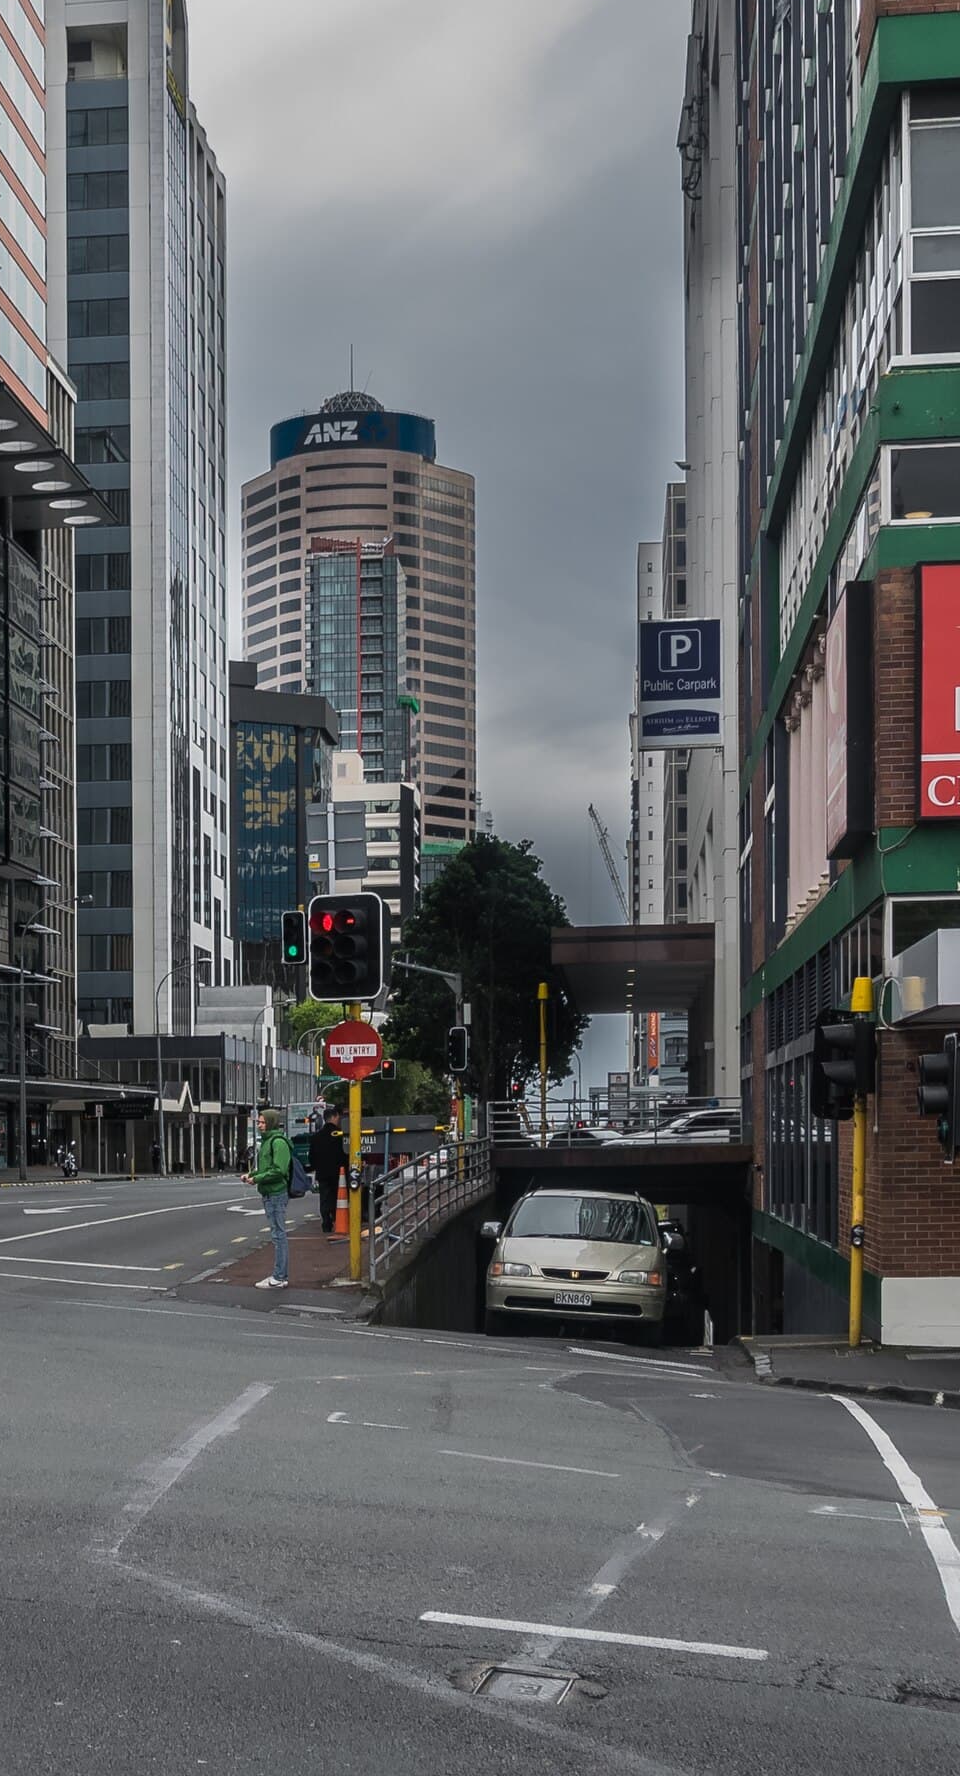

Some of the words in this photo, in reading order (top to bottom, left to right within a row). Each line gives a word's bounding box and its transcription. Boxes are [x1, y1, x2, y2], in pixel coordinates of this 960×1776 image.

[304, 420, 358, 445] ANZ
[671, 634, 692, 667] P
[643, 679, 674, 692] Public
[677, 677, 717, 692] Carpark
[685, 715, 717, 723] ELLIOTT
[335, 1046, 345, 1055] NO
[349, 1046, 370, 1055] ENTRY
[555, 1292, 591, 1305] BKN849
